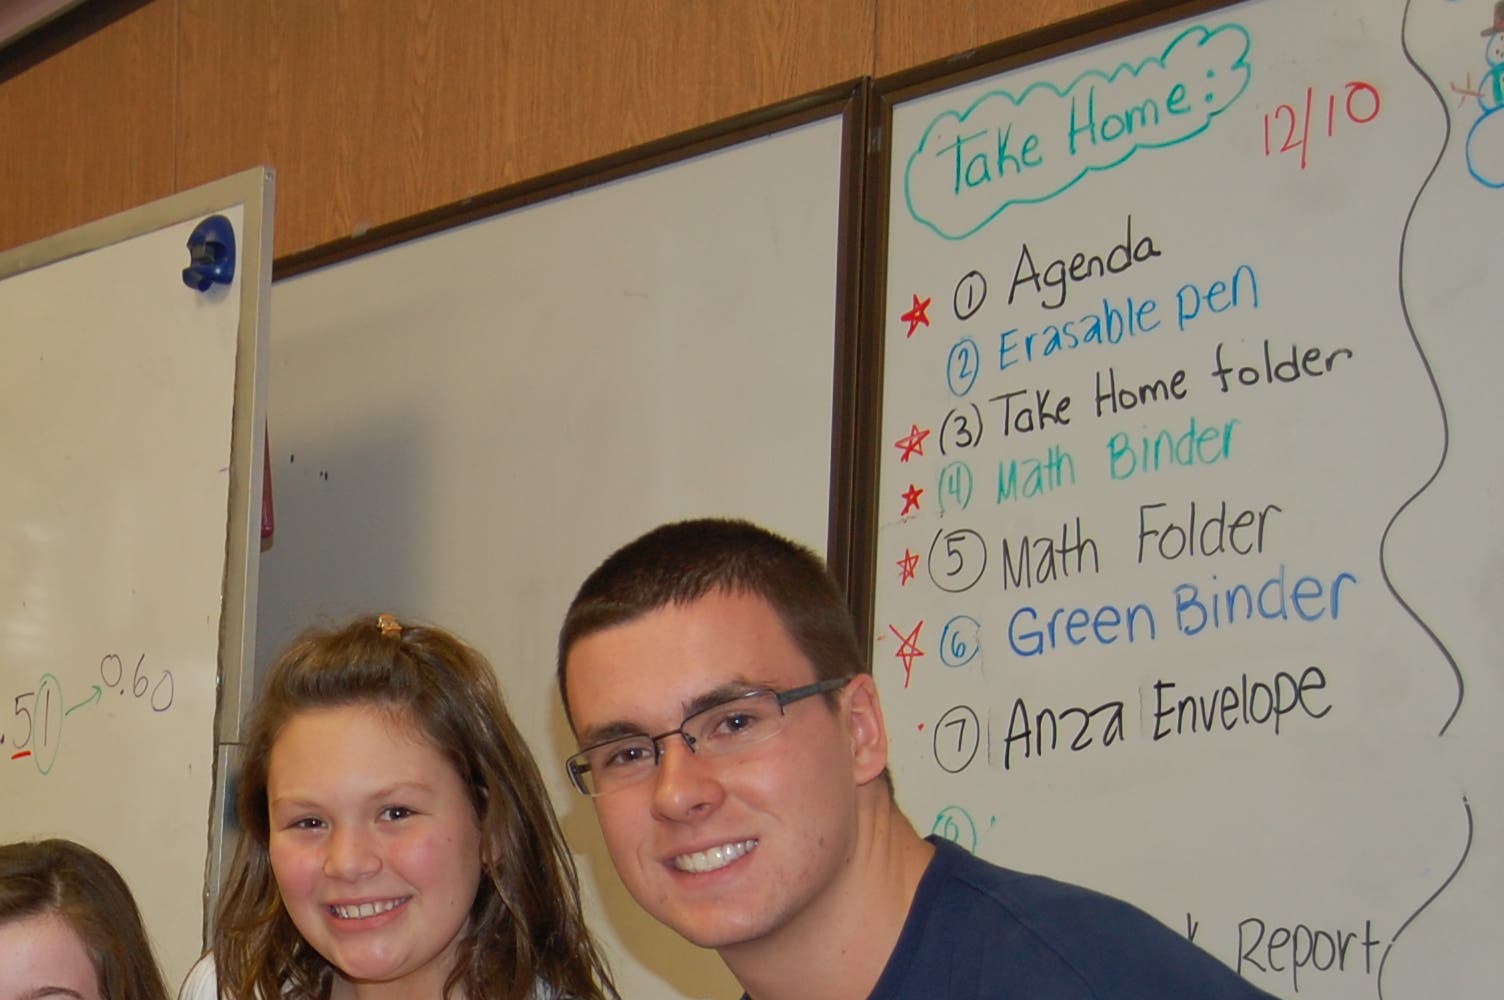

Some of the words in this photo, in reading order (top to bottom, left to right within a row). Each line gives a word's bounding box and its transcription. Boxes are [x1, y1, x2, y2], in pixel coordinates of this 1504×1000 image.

[936, 130, 1044, 195] Take
[1264, 81, 1381, 169] 12/10
[1008, 214, 1162, 309] Agenda
[999, 289, 1162, 371] Erasable
[1176, 264, 1260, 333] pen
[989, 389, 1072, 438] Take
[1095, 367, 1189, 418] Home
[1211, 340, 1353, 394] folder
[996, 445, 1076, 506] Math
[1107, 418, 1244, 483] Binder
[1002, 517, 1100, 591] Math
[1137, 501, 1283, 565] Folder
[1008, 602, 1157, 658] Green
[1174, 564, 1358, 636] Binder
[1152, 666, 1333, 743] Envelope
[1238, 918, 1380, 993] Report
